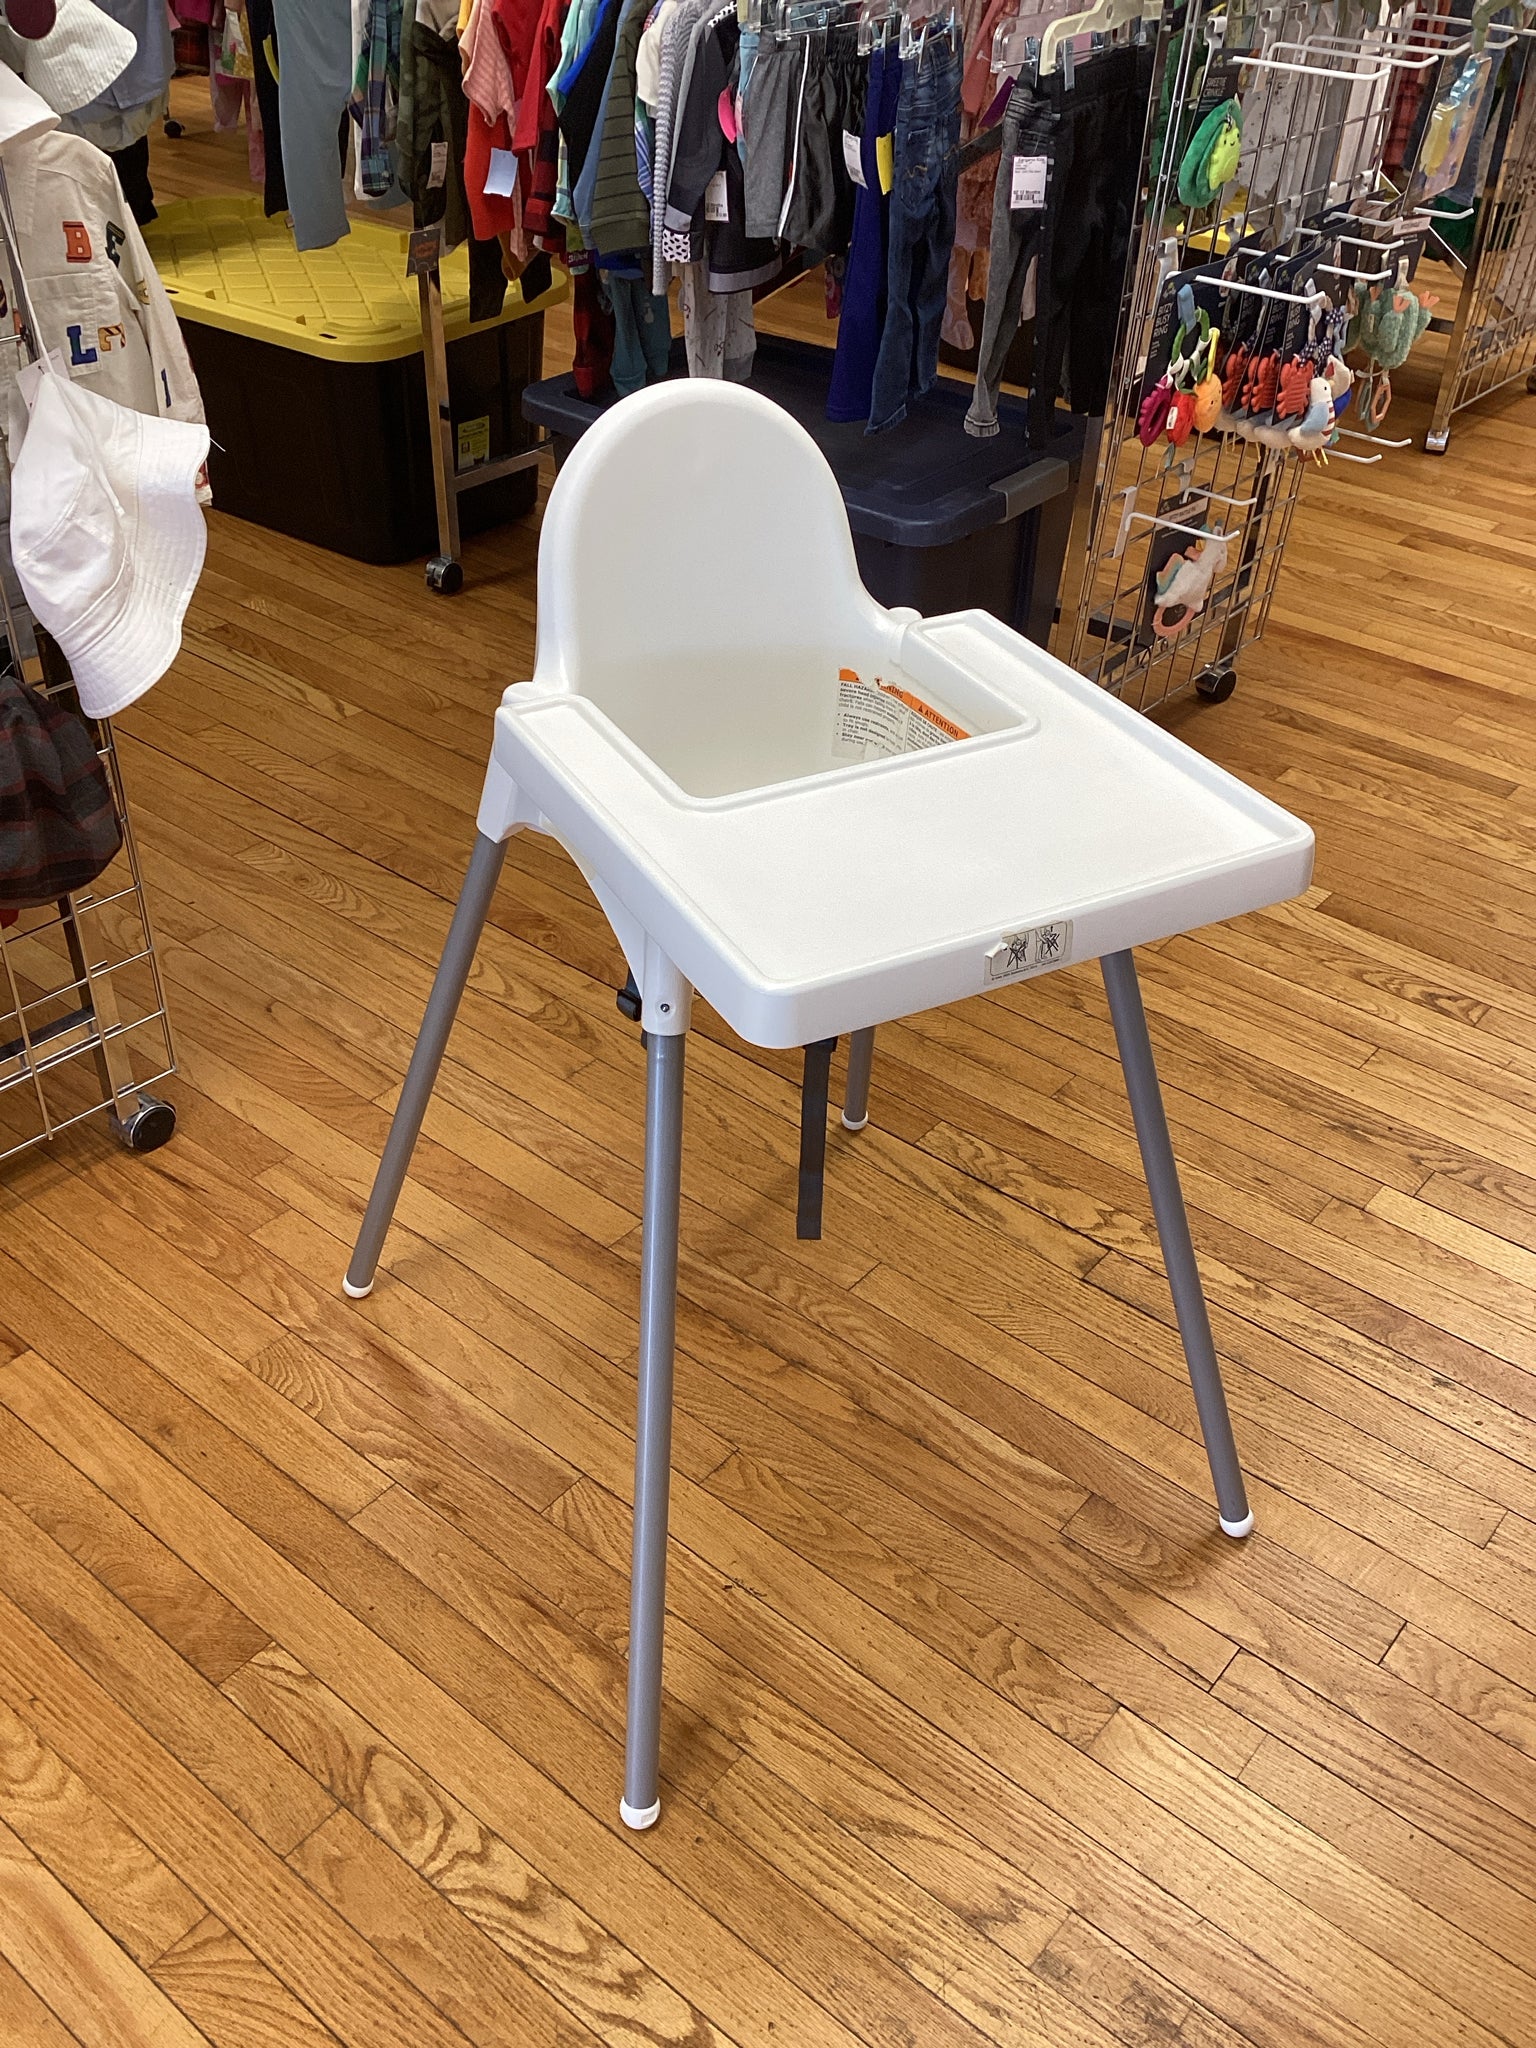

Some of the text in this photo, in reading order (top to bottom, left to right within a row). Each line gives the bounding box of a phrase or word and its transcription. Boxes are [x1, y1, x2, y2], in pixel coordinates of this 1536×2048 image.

[62, 221, 92, 263] B
[66, 325, 98, 365] L
[843, 712, 861, 720] Always
[924, 709, 959, 738] ATTENTION
